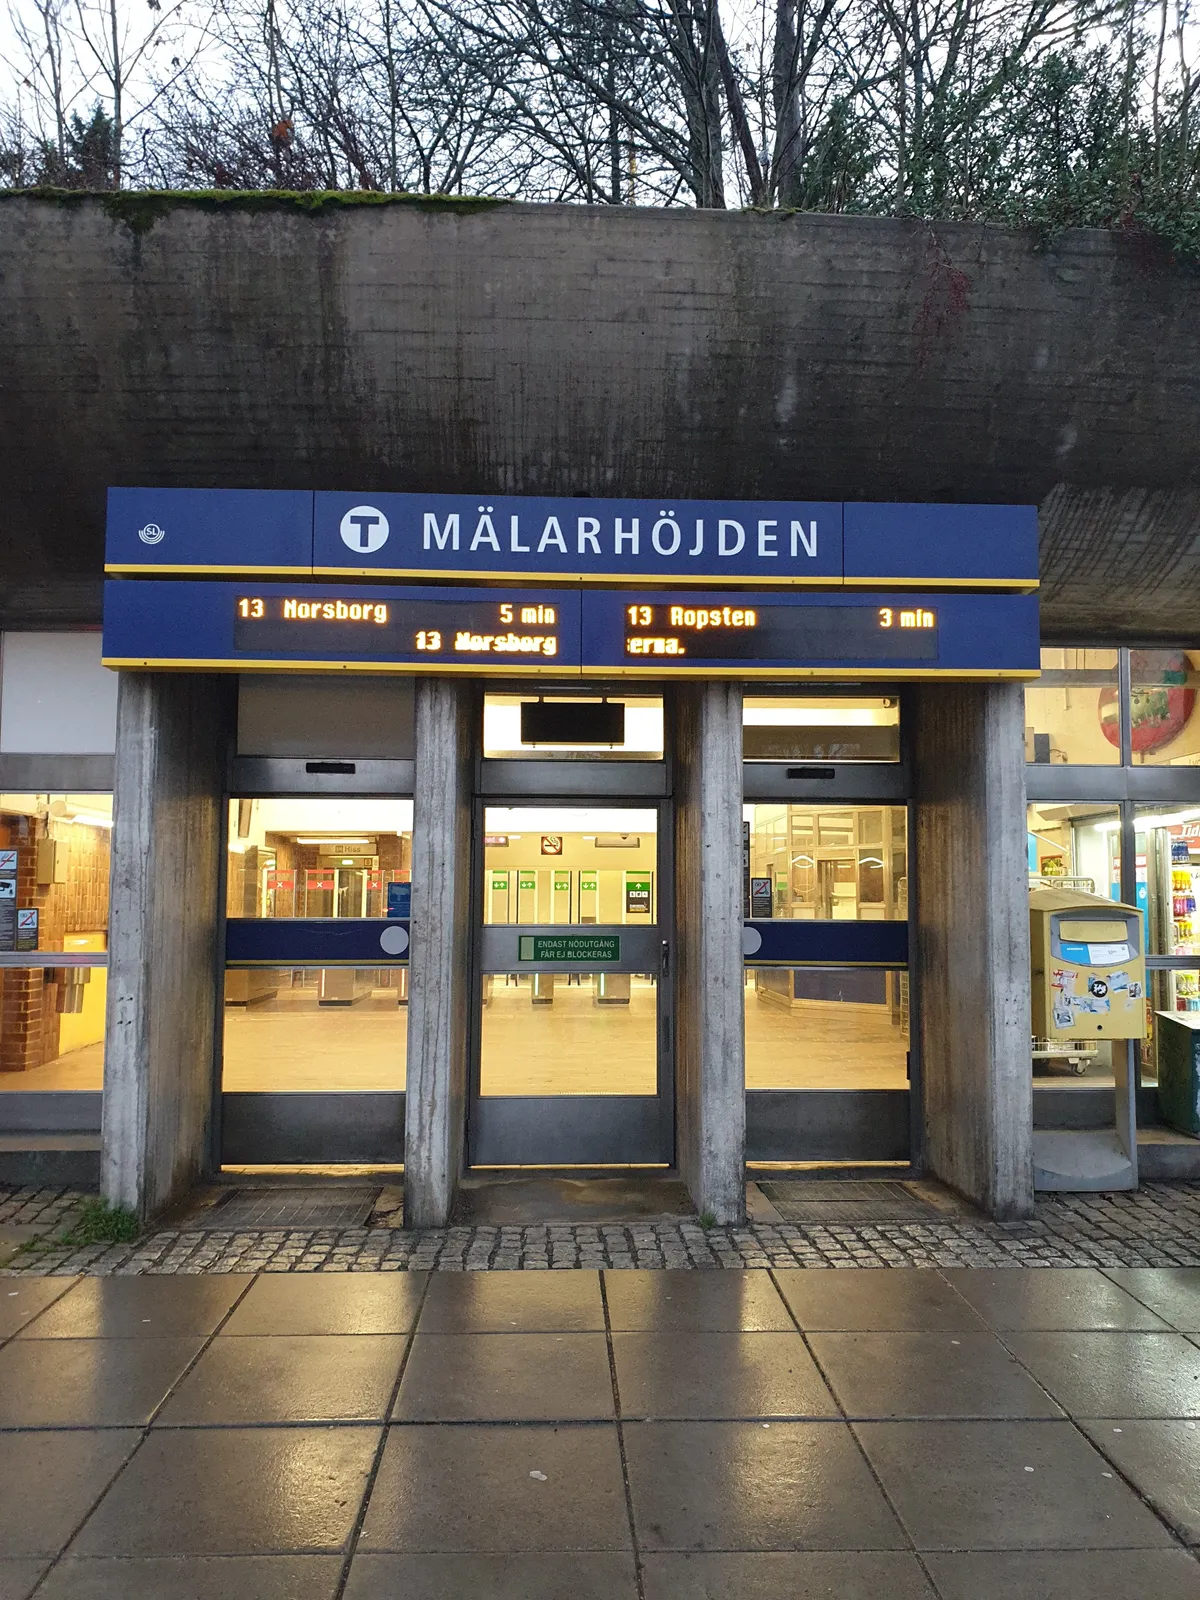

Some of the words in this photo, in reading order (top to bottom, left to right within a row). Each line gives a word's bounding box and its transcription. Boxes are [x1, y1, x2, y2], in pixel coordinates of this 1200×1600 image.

[422, 506, 818, 556] MÄLARHÖJDEN
[239, 598, 264, 618] 13
[283, 599, 388, 624] Norsborg
[500, 604, 513, 624] 5
[521, 605, 556, 624] min
[627, 605, 652, 626] 13
[670, 606, 756, 630] Ropsten
[879, 608, 893, 627] 3
[900, 608, 934, 628] min
[415, 630, 442, 651] 13
[454, 632, 557, 656] Norsborg
[627, 637, 686, 655] erna.
[538, 940, 567, 948] ENDAST
[568, 939, 615, 949] NÖDUTGÅNG
[540, 949, 555, 959] FÅR
[556, 950, 566, 959] EJ
[567, 950, 613, 959] BLOCKERAS
